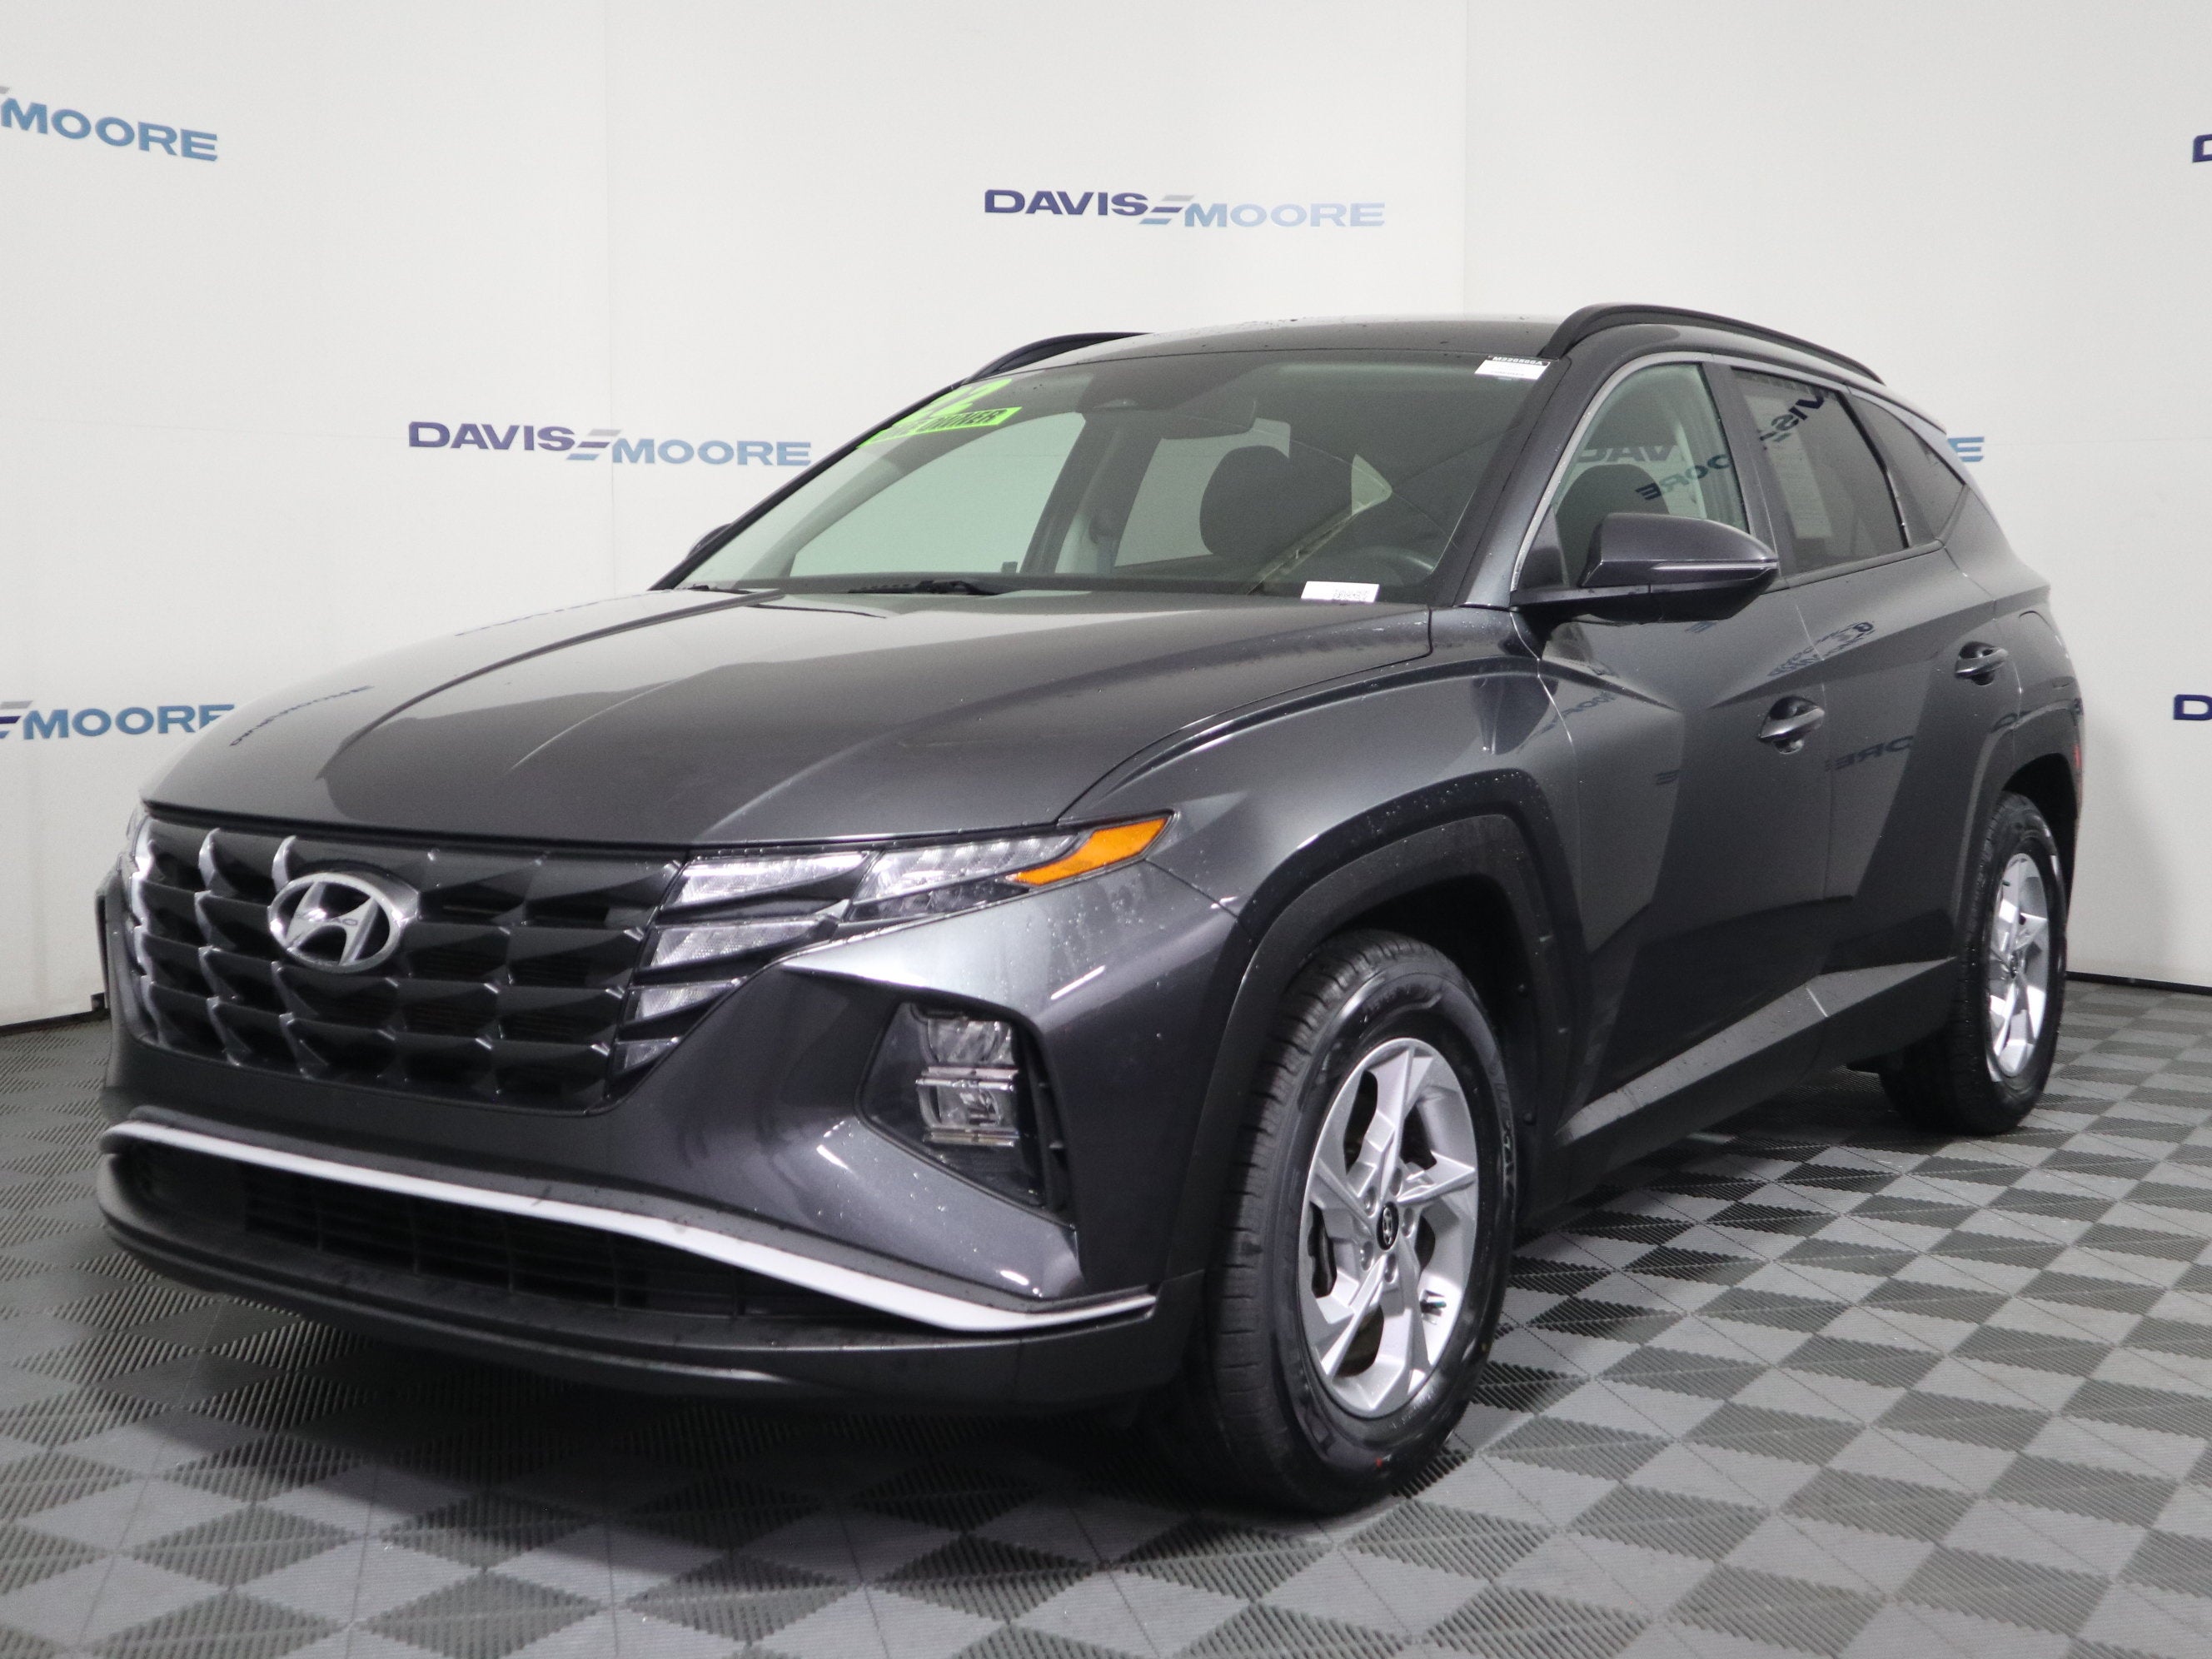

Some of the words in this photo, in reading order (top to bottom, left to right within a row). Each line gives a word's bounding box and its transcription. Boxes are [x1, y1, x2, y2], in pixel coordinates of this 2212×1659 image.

[0, 97, 218, 162] MOORE
[984, 189, 1148, 217] DAVIS
[1184, 202, 1385, 228] MOORE
[408, 421, 575, 451] DAVIS
[612, 438, 811, 466] MOORE
